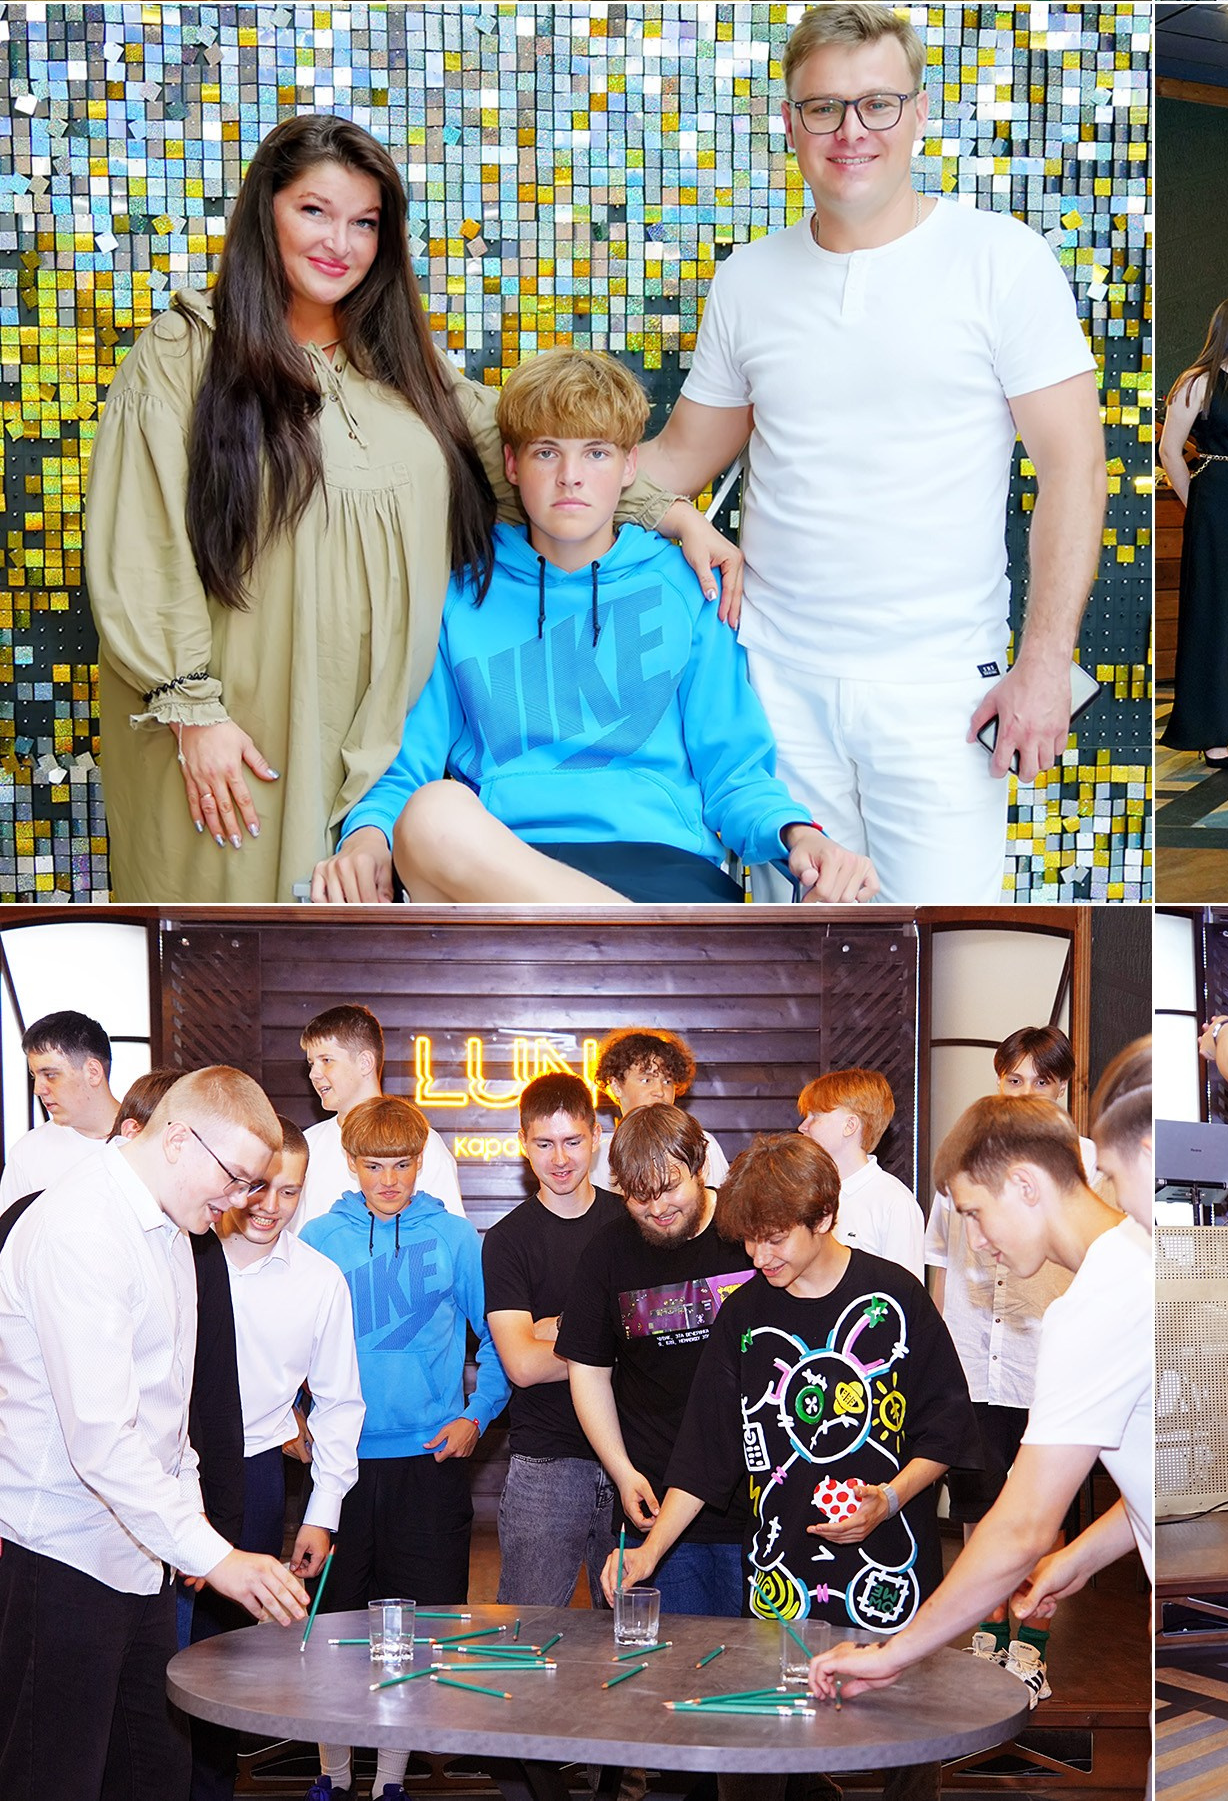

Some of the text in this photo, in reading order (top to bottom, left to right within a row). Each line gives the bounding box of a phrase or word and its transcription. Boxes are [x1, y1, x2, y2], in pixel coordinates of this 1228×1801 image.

[454, 584, 672, 768] NIKE
[415, 1036, 622, 1109] LUN
[344, 1238, 440, 1338] IKE
